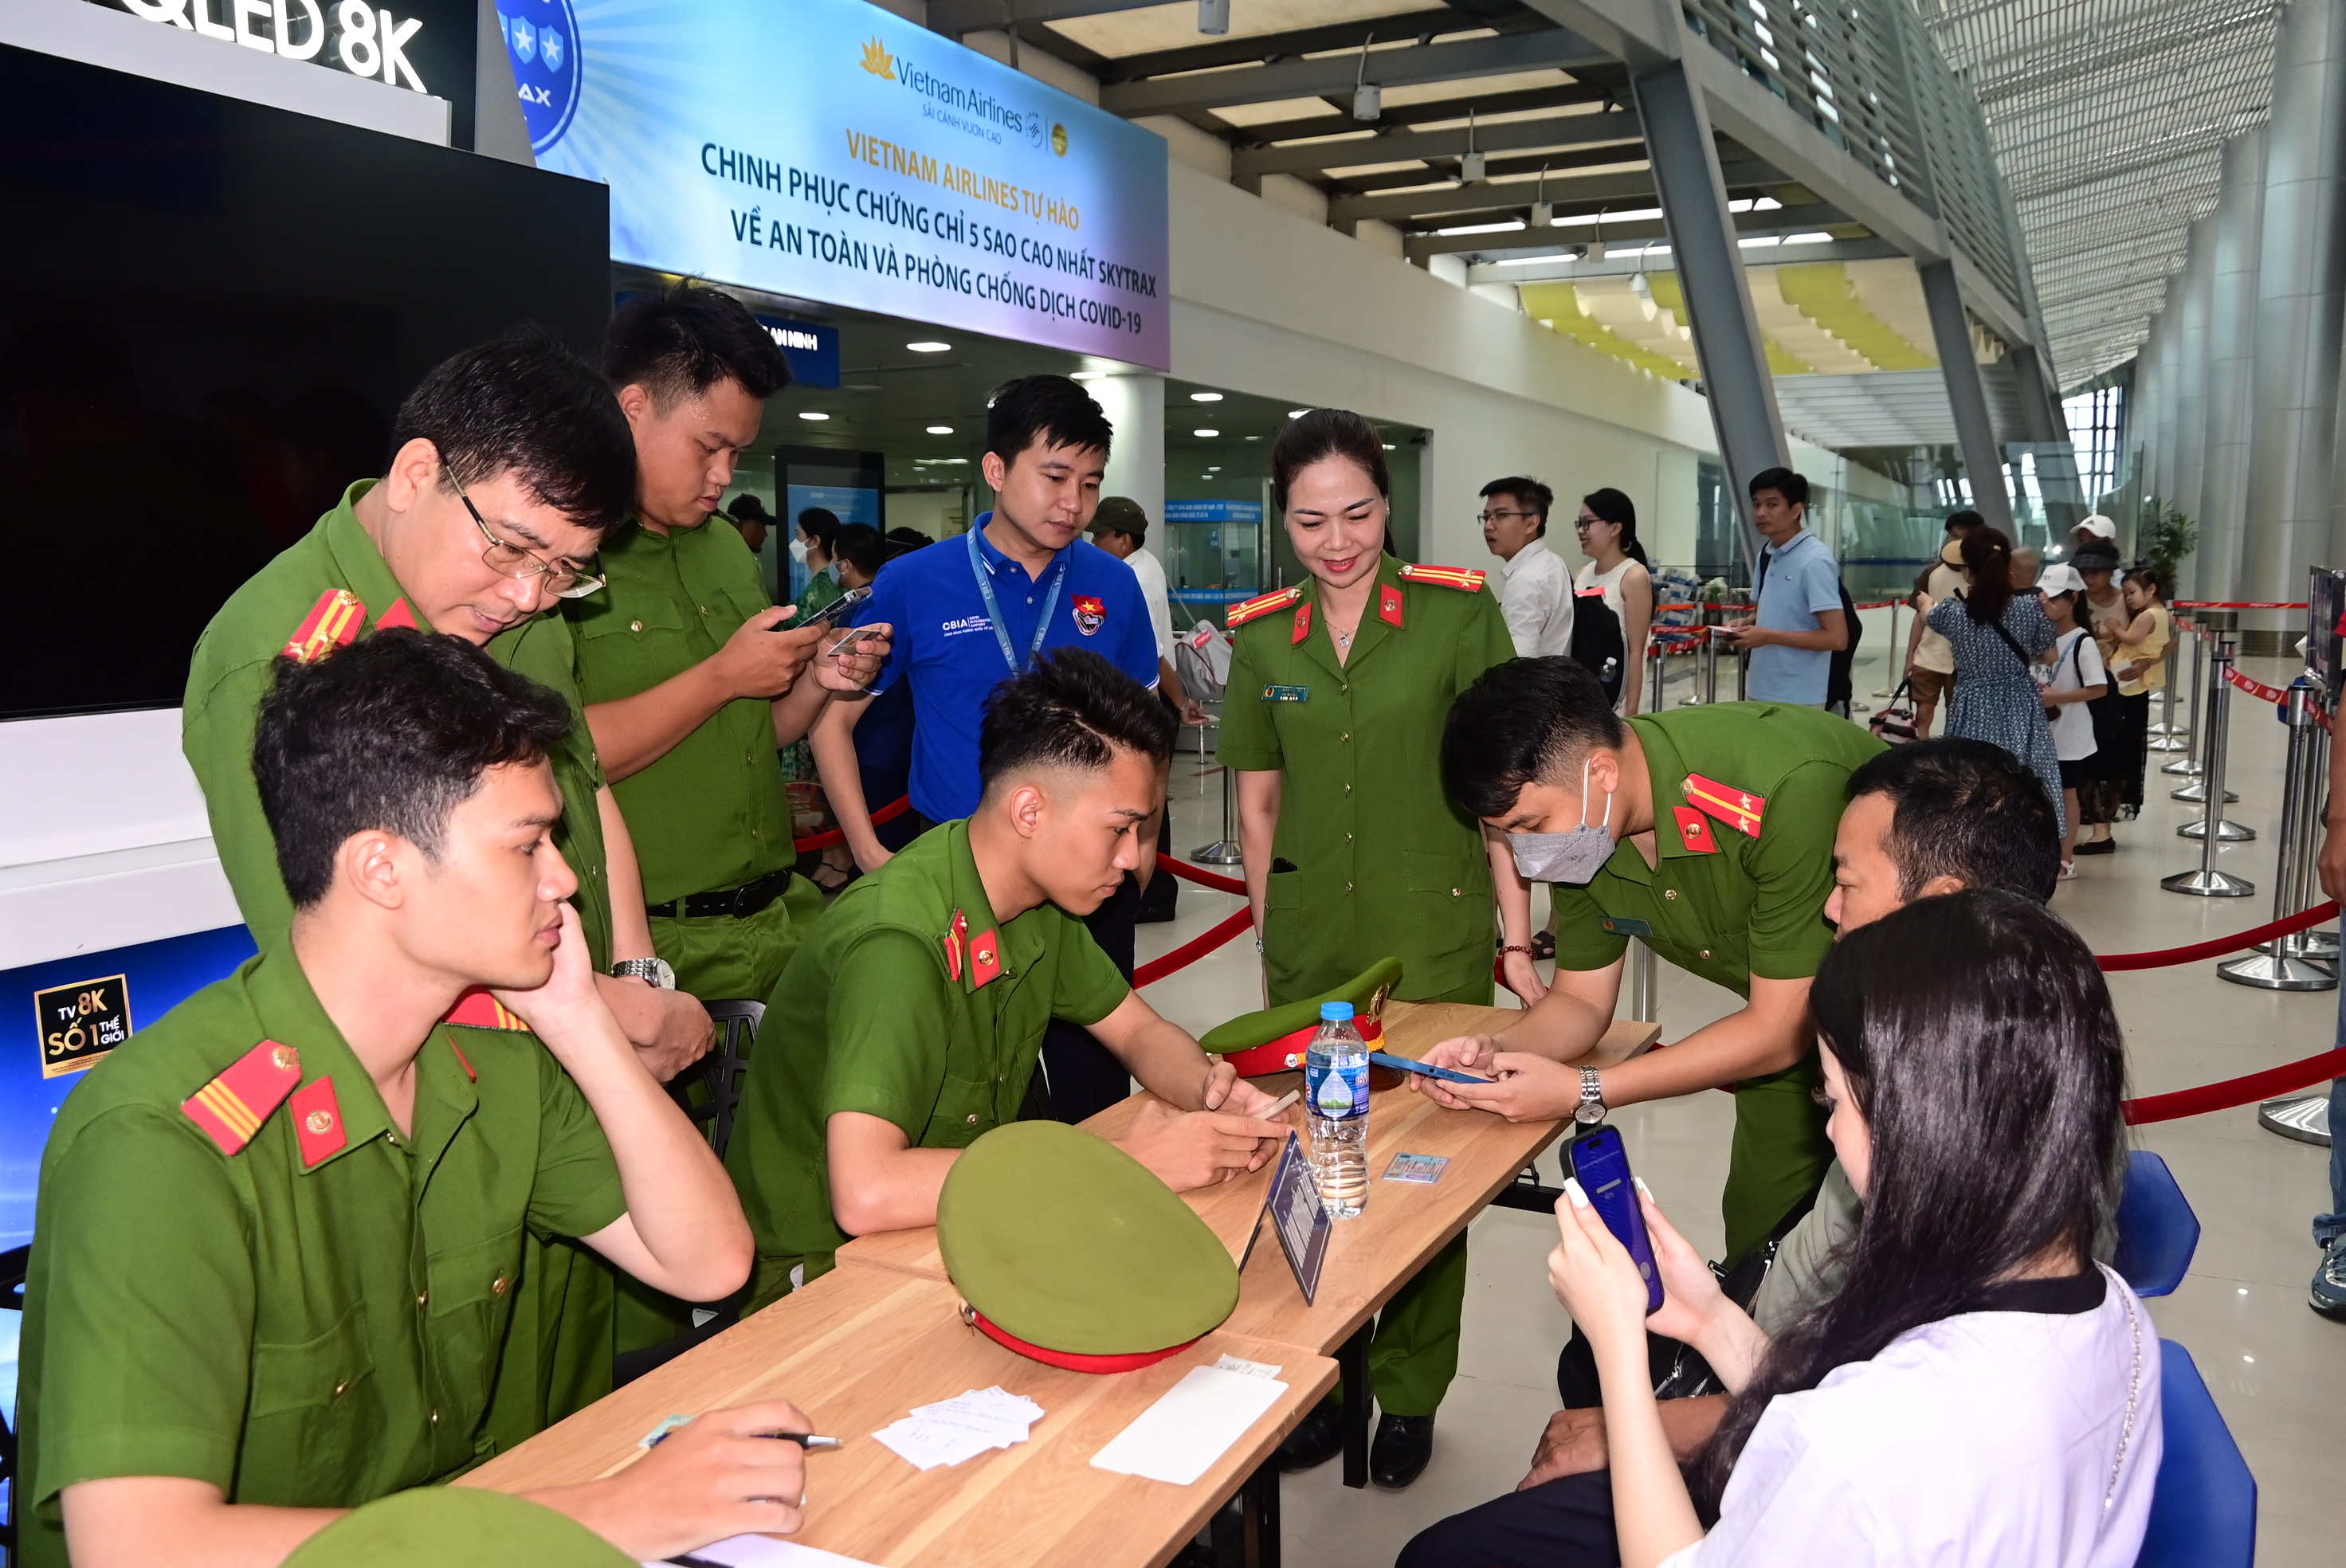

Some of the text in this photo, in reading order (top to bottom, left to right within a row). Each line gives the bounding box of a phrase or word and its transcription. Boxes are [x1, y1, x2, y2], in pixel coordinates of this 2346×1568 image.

[338, 0, 428, 94] 8K
[986, 128, 1002, 144] CAO
[846, 128, 1080, 230] VIETNAM AIRLINES TỰ HÀO
[701, 142, 1157, 298] CHINH PHỤC CHỨNG CHỈ 5 SAO CAO NHẤT SKYTRAX
[730, 205, 1142, 334] VỀ AN TOÀN VÀ PHÒNG CHỐNG DỊCH COVID-19
[981, 580, 992, 600] CBIA
[942, 618, 968, 631] CBIA
[1035, 627, 1046, 646] CBIA
[1002, 641, 1014, 661] CBIA
[57, 988, 108, 1021] TV 8K
[99, 1013, 120, 1033] THẾ
[48, 1017, 99, 1056] SỐ 1
[100, 1028, 125, 1045] GIỚI
